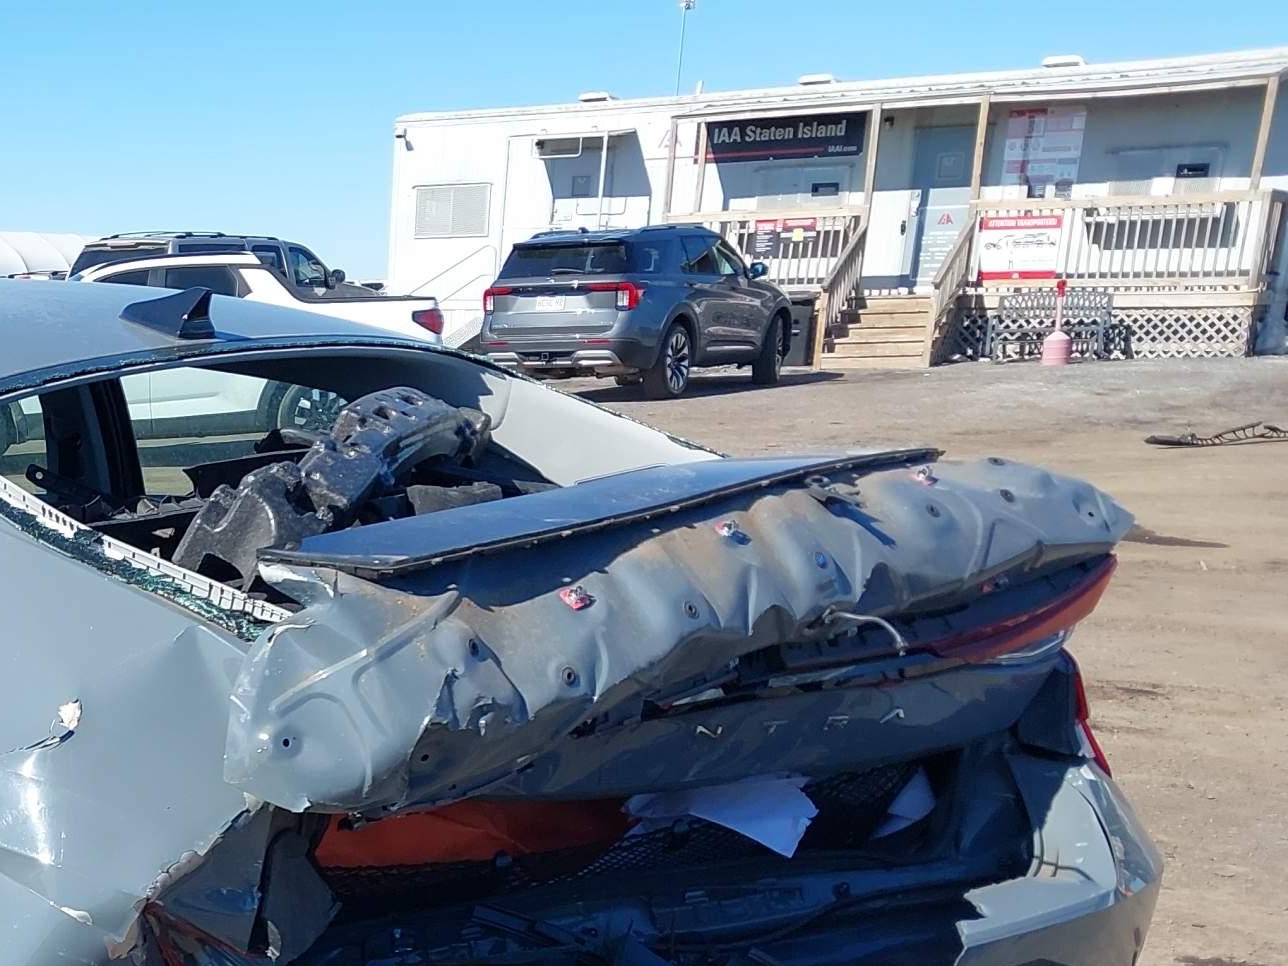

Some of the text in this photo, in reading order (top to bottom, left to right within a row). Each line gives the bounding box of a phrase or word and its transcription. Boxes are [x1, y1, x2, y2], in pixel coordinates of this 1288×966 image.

[713, 119, 847, 144] IAA Staten Island
